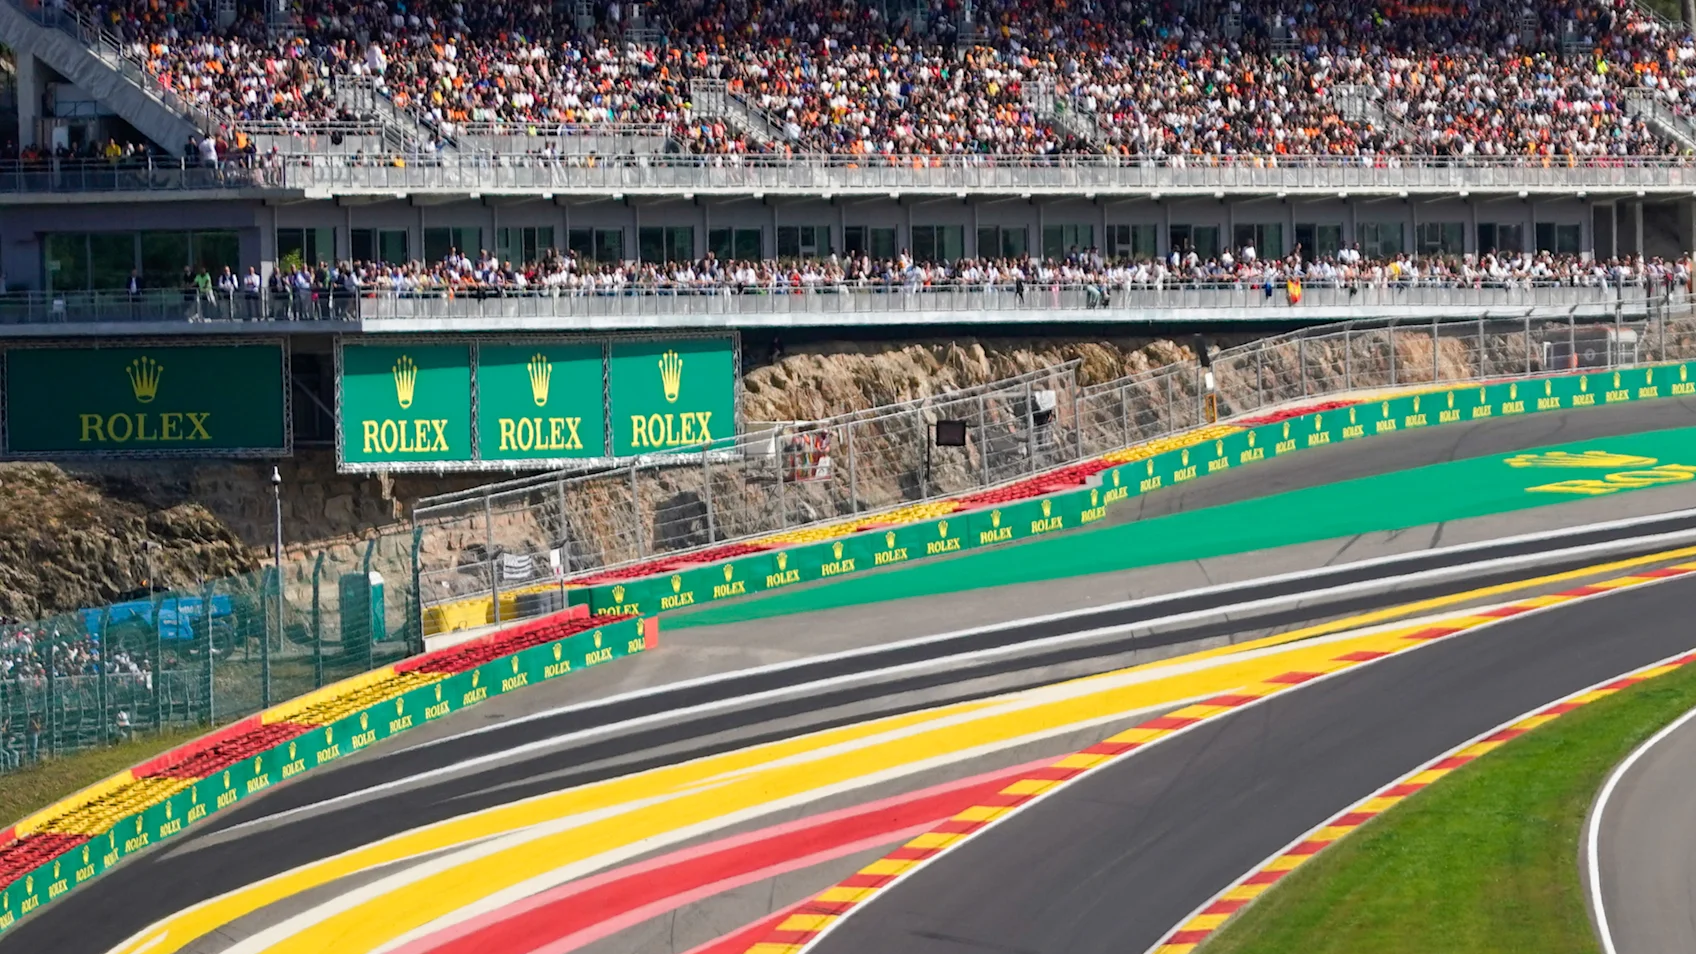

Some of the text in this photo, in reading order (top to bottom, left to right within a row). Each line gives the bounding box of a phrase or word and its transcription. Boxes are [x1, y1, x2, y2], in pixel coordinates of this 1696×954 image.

[80, 412, 213, 442] ROLEX
[362, 418, 449, 454] ROLEX
[498, 416, 583, 452] ROLEX
[631, 411, 713, 448] ROLEX
[1209, 456, 1228, 471] ROLEX
[1241, 448, 1263, 462] ROLEX
[1175, 465, 1195, 481] ROLEX
[1141, 477, 1160, 493] ROLEX
[1032, 515, 1062, 532] ROLEX
[981, 526, 1011, 543] ROLEX
[928, 538, 960, 553] ROLEX
[875, 547, 907, 566] ROLEX
[822, 558, 854, 577] ROLEX
[767, 568, 799, 586] ROLEX
[714, 580, 745, 599] ROLEX
[662, 590, 693, 608] ROLEX
[586, 648, 612, 665] ROLEX
[544, 660, 571, 678] ROLEX
[502, 672, 528, 691] ROLEX
[463, 686, 487, 705] ROLEX
[425, 701, 449, 719] ROLEX
[389, 716, 412, 734] ROLEX
[282, 758, 305, 778] ROLEX
[247, 774, 269, 794] ROLEX
[217, 788, 238, 809] ROLEX
[159, 818, 181, 838] ROLEX
[125, 832, 148, 853] ROLEX
[48, 879, 67, 897] ROLEX
